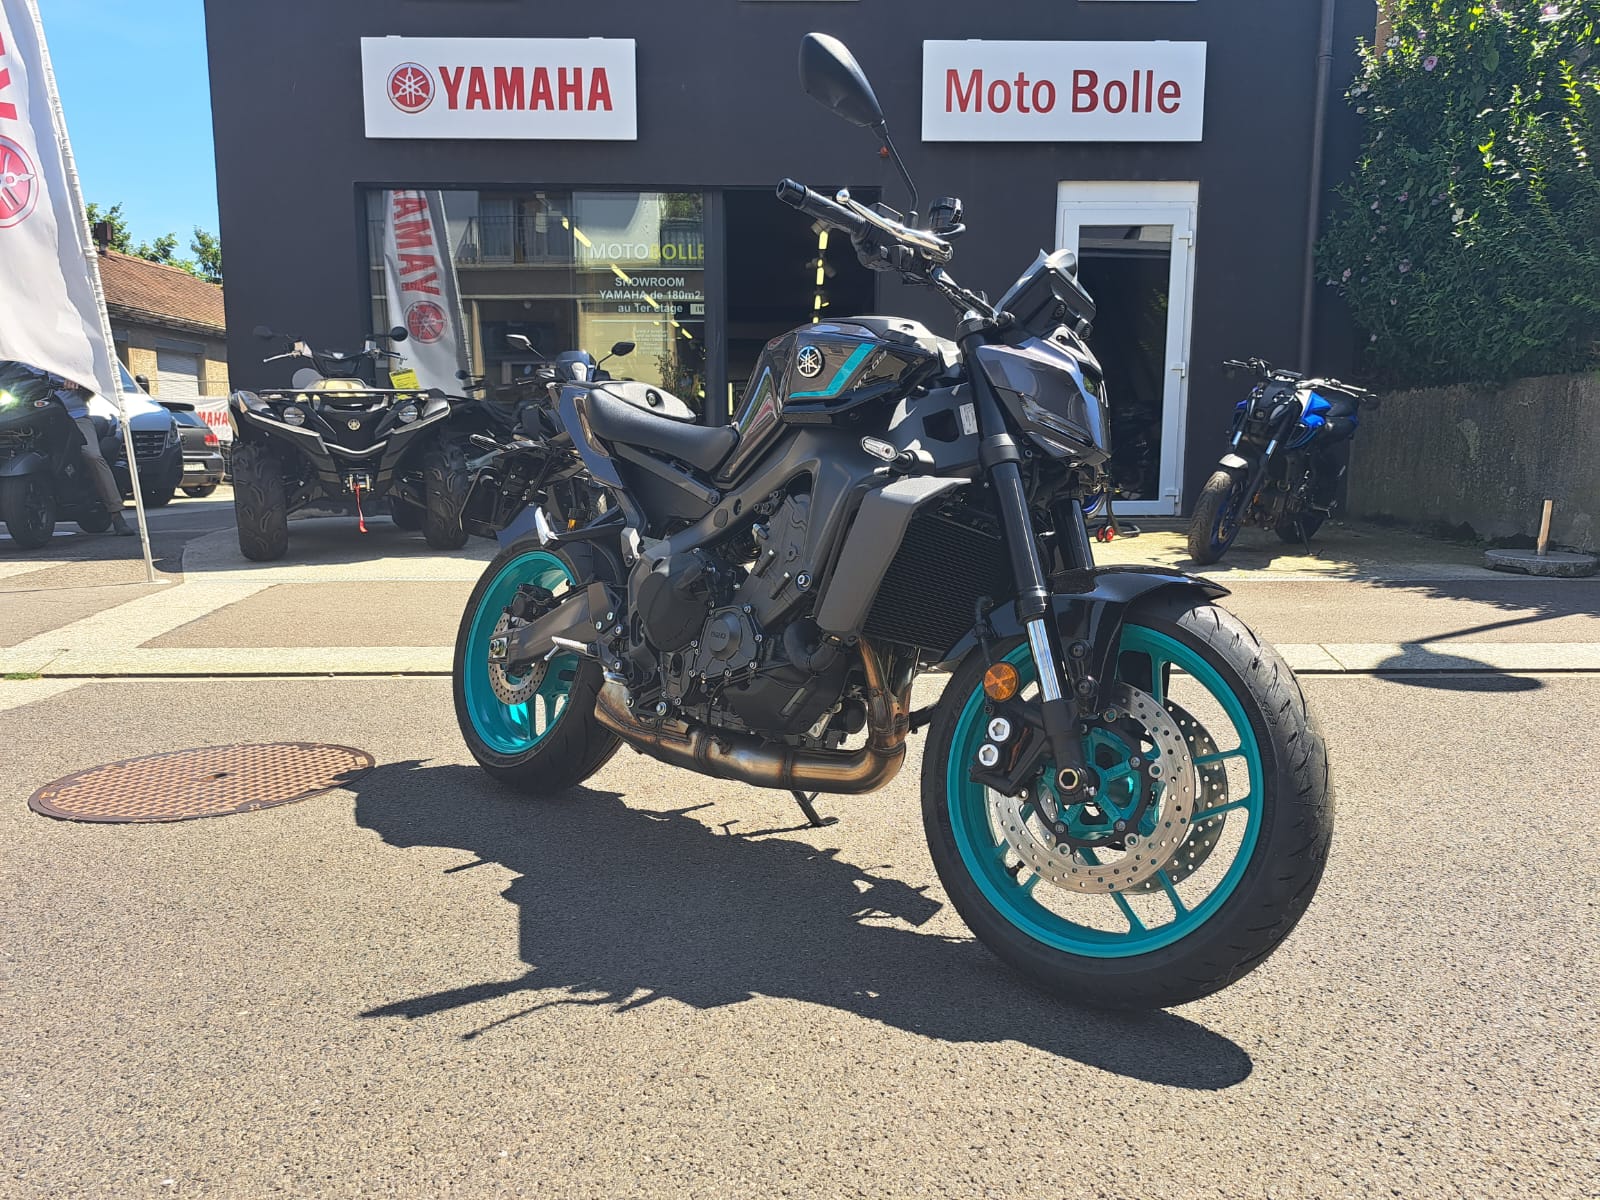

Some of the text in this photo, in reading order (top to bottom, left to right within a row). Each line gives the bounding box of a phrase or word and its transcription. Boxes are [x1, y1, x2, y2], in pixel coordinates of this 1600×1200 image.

[438, 66, 613, 111] YAMAHA
[945, 69, 1181, 114] Moto Bolle
[615, 277, 684, 287] SHOWROOM
[599, 290, 646, 300] YAMAHA
[650, 290, 663, 300] de
[617, 305, 631, 313] au
[197, 411, 228, 426] MAHA
